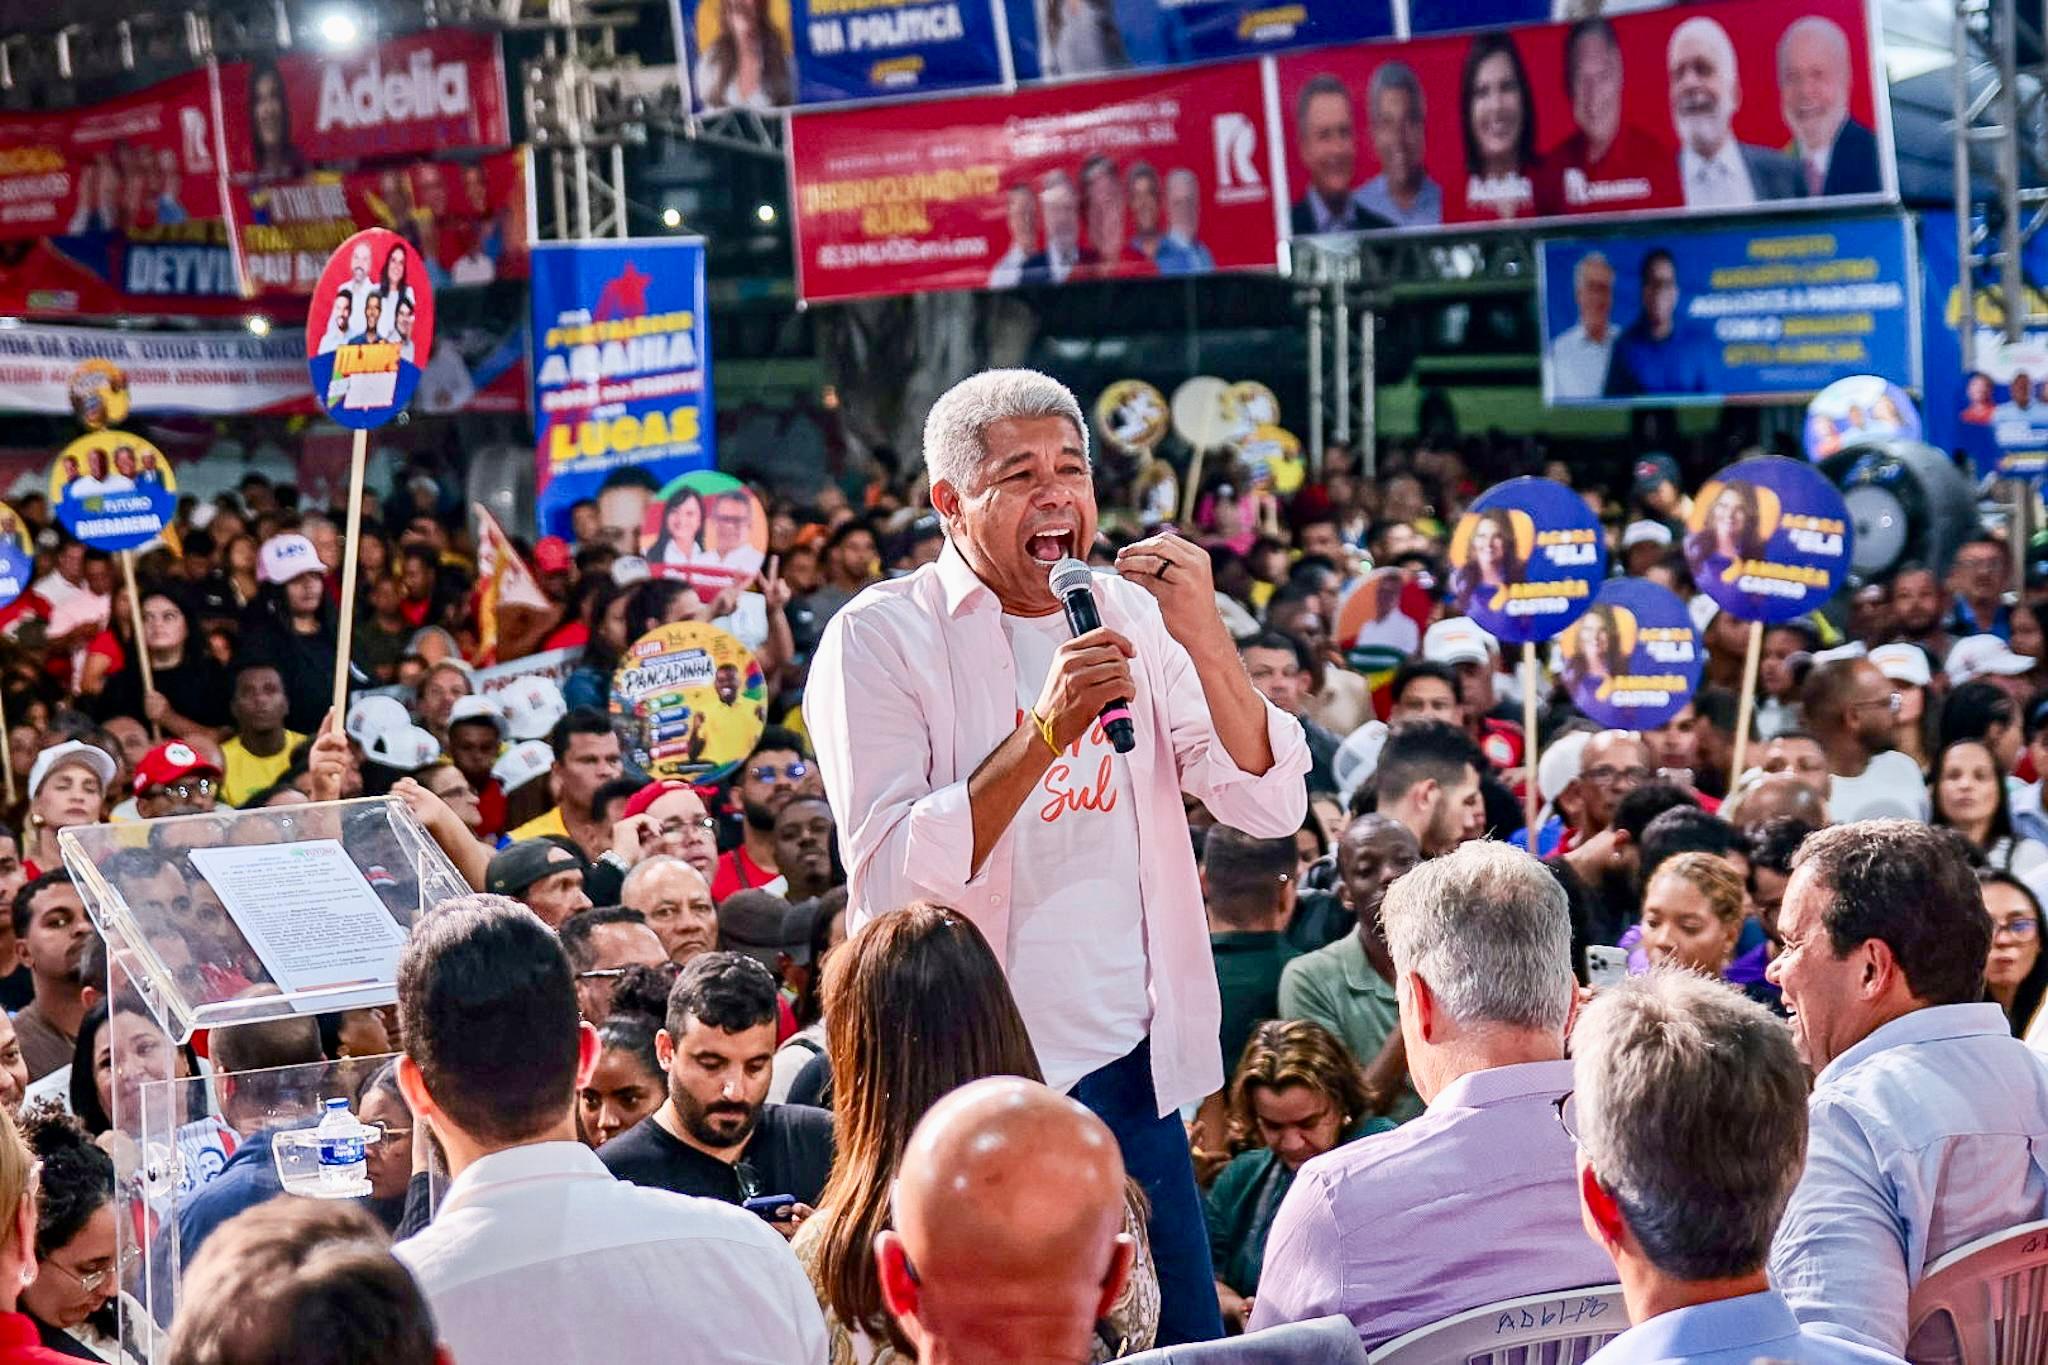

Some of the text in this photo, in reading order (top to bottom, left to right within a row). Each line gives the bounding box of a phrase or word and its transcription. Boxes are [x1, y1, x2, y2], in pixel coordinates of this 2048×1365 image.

[316, 47, 470, 131] Adelia
[550, 404, 700, 462] LUCAS
[623, 656, 716, 698] PANCADINHA
[1041, 754, 1118, 823] Sul
